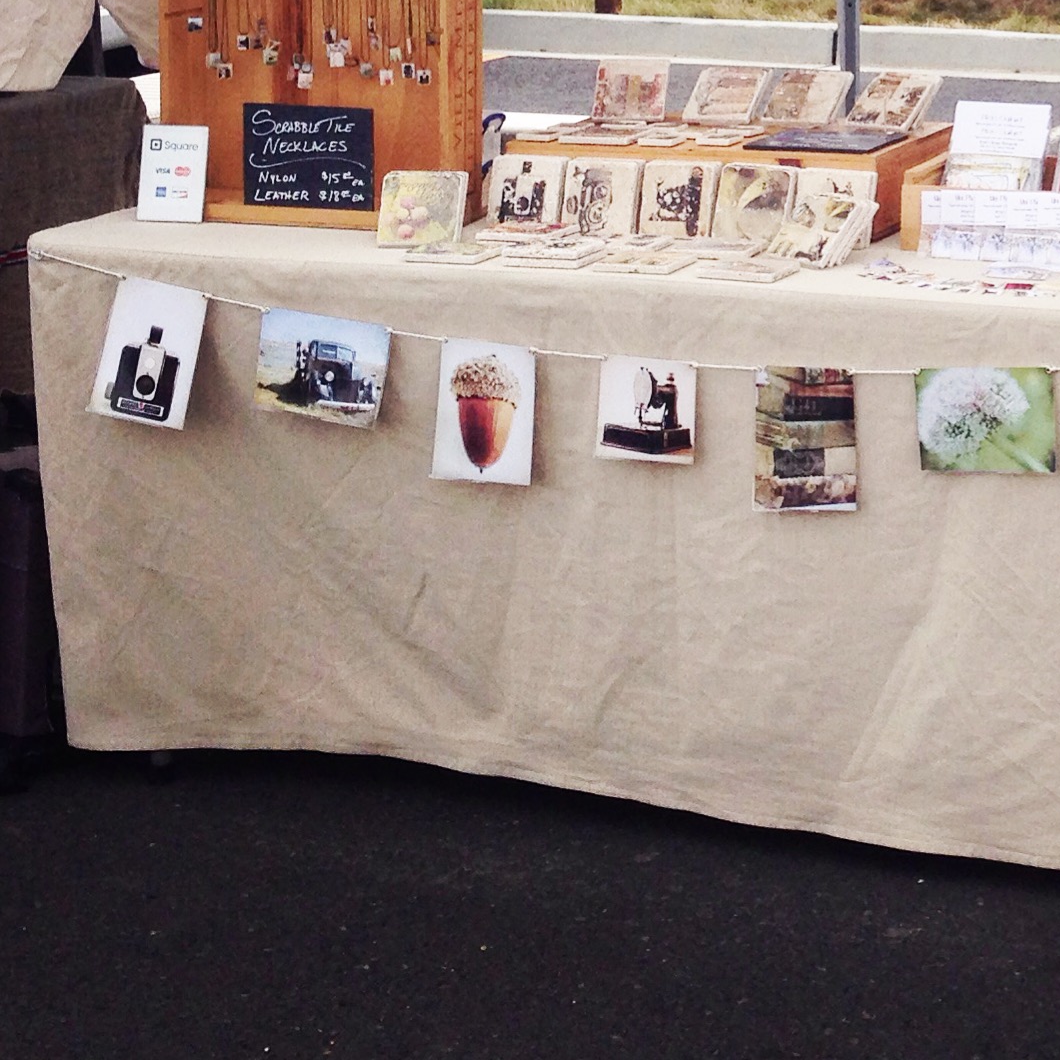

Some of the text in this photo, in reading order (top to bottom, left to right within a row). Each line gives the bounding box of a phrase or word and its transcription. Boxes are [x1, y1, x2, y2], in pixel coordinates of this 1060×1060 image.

[252, 109, 355, 136] SCRABBLE TILE
[164, 140, 199, 151] Square
[263, 137, 348, 154] NECKLACES
[259, 171, 297, 184] NYLON
[254, 189, 310, 201] LEATHER
